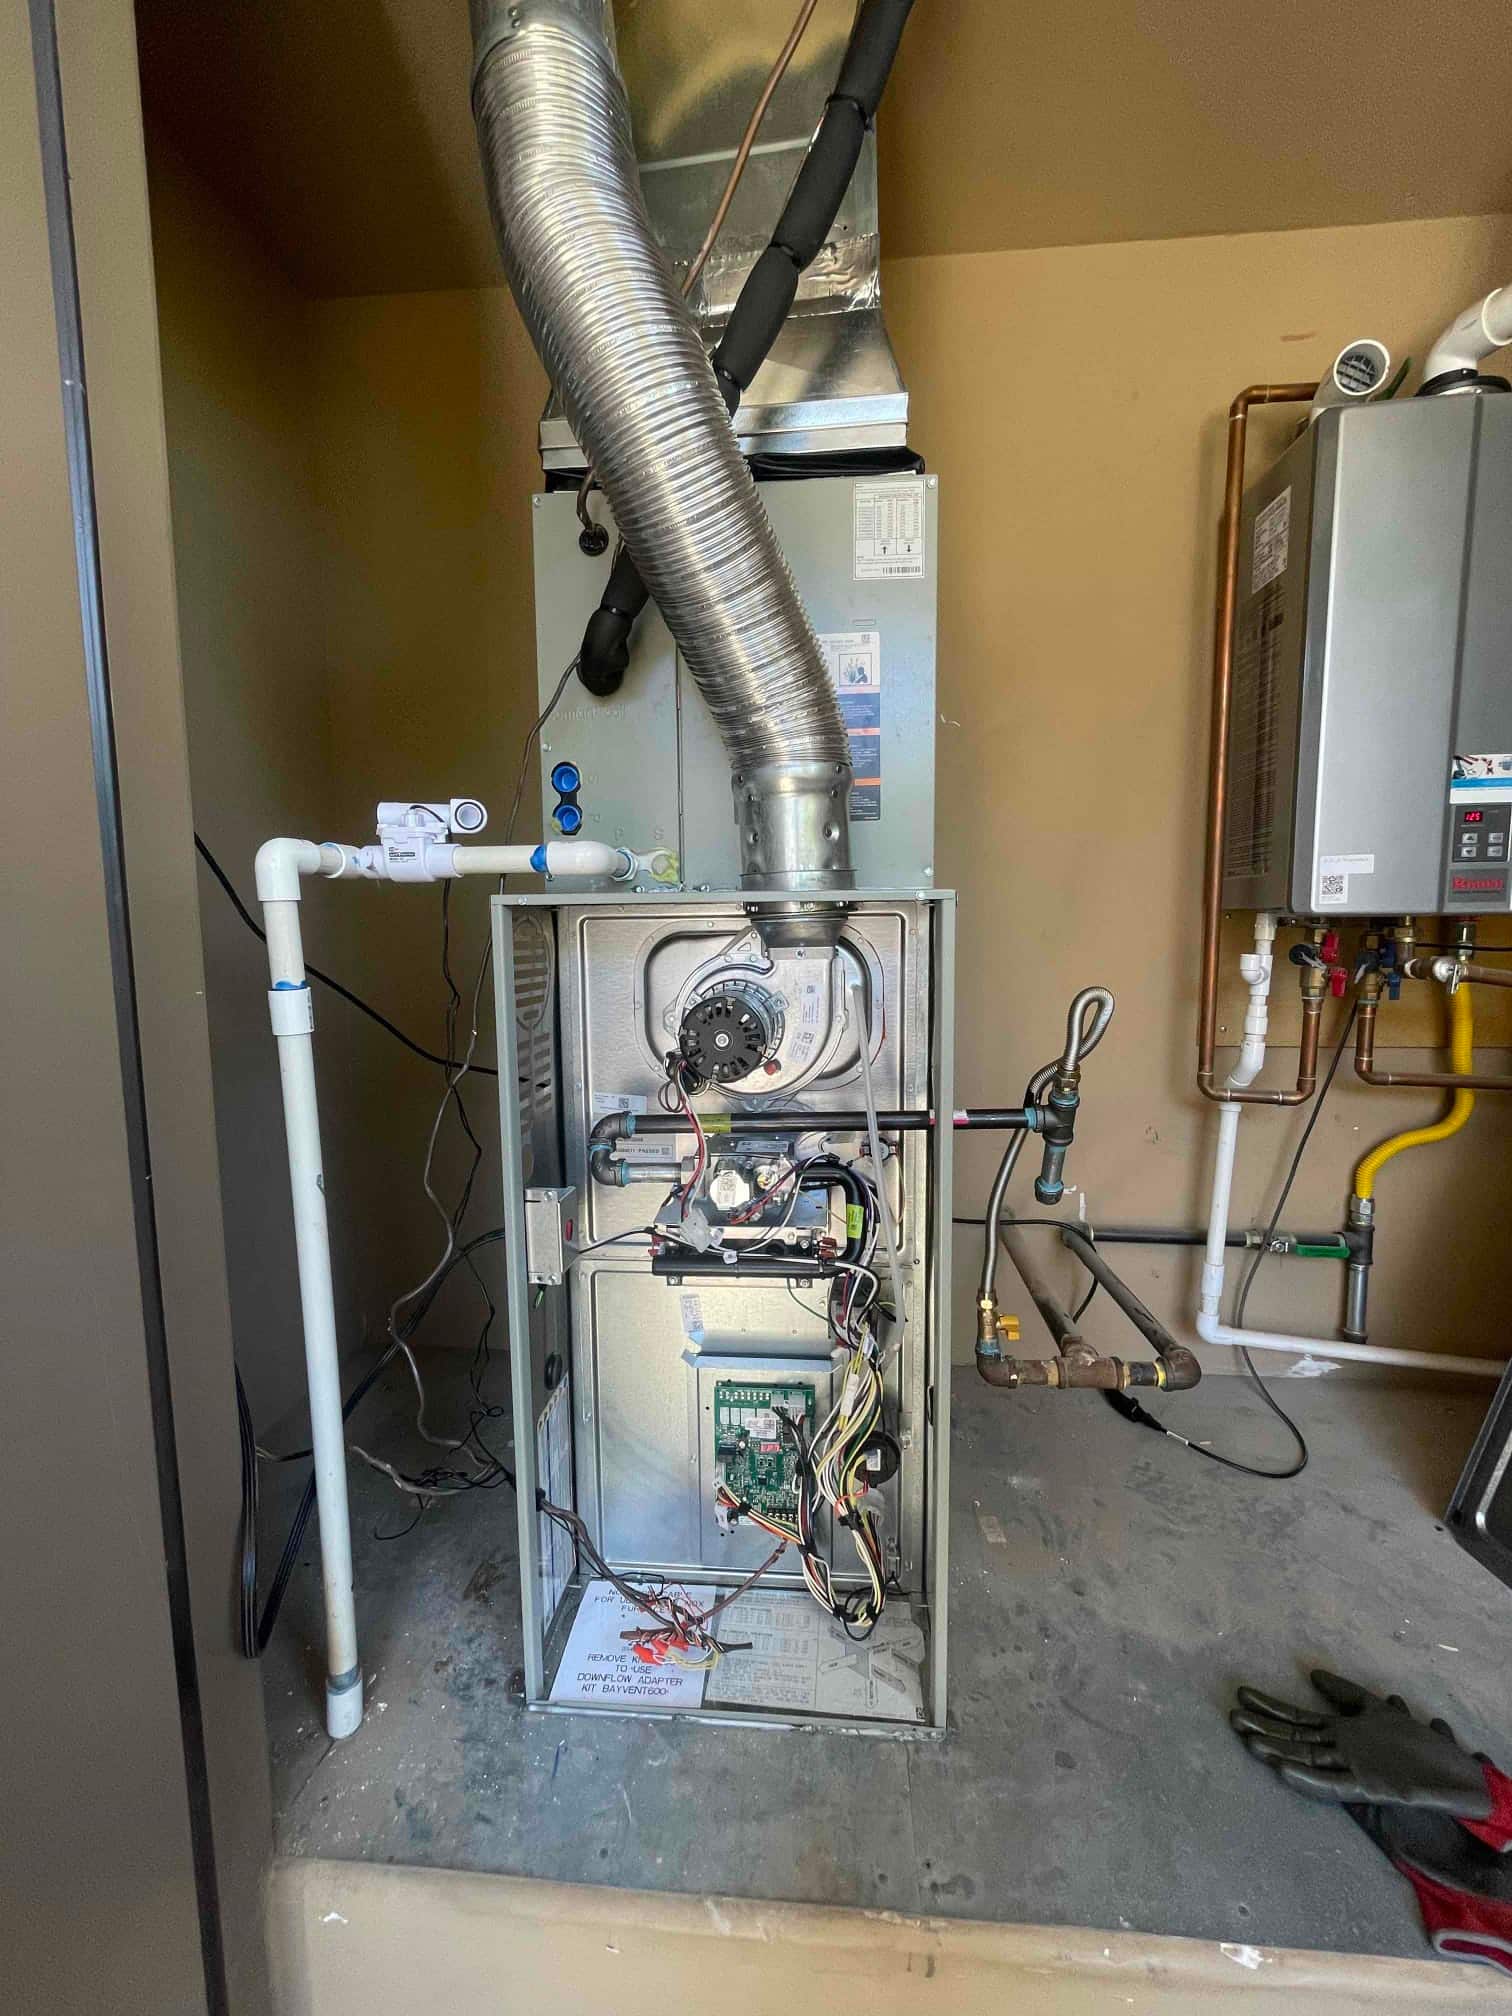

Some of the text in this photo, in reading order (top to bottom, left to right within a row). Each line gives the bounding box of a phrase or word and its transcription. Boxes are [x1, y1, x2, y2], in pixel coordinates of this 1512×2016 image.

[594, 1595, 614, 1604] FOR
[587, 1653, 627, 1663] REMOVE
[616, 1664, 652, 1674] TO USE
[577, 1672, 683, 1686] DOWNFLOW ADAPTER
[581, 1683, 598, 1693] KIT
